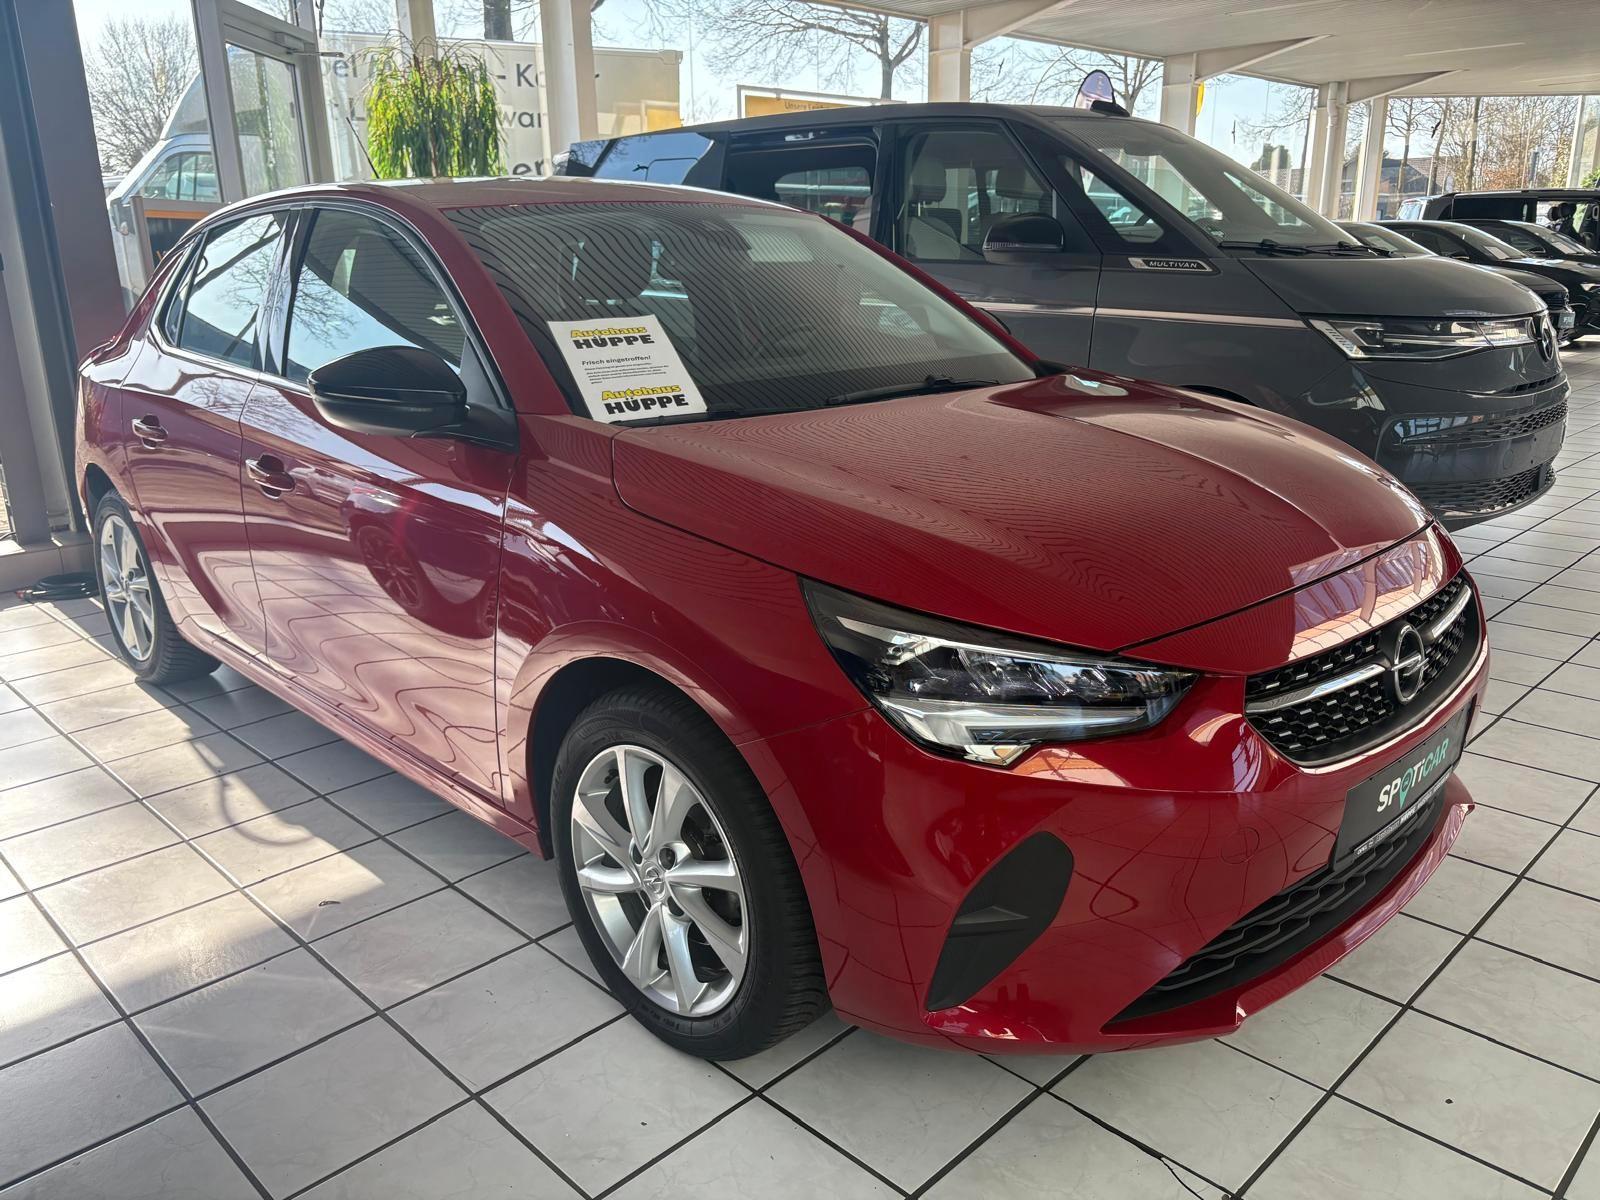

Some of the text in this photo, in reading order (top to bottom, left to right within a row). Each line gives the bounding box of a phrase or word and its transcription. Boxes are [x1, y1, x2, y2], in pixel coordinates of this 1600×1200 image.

[1149, 260, 1198, 269] MULTIVAN
[570, 326, 648, 338] Autohaus
[572, 334, 655, 350] HÜPPE
[606, 355, 651, 364] eingetroffen!
[602, 384, 681, 401] Autohaus
[603, 393, 689, 415] HÜPPE
